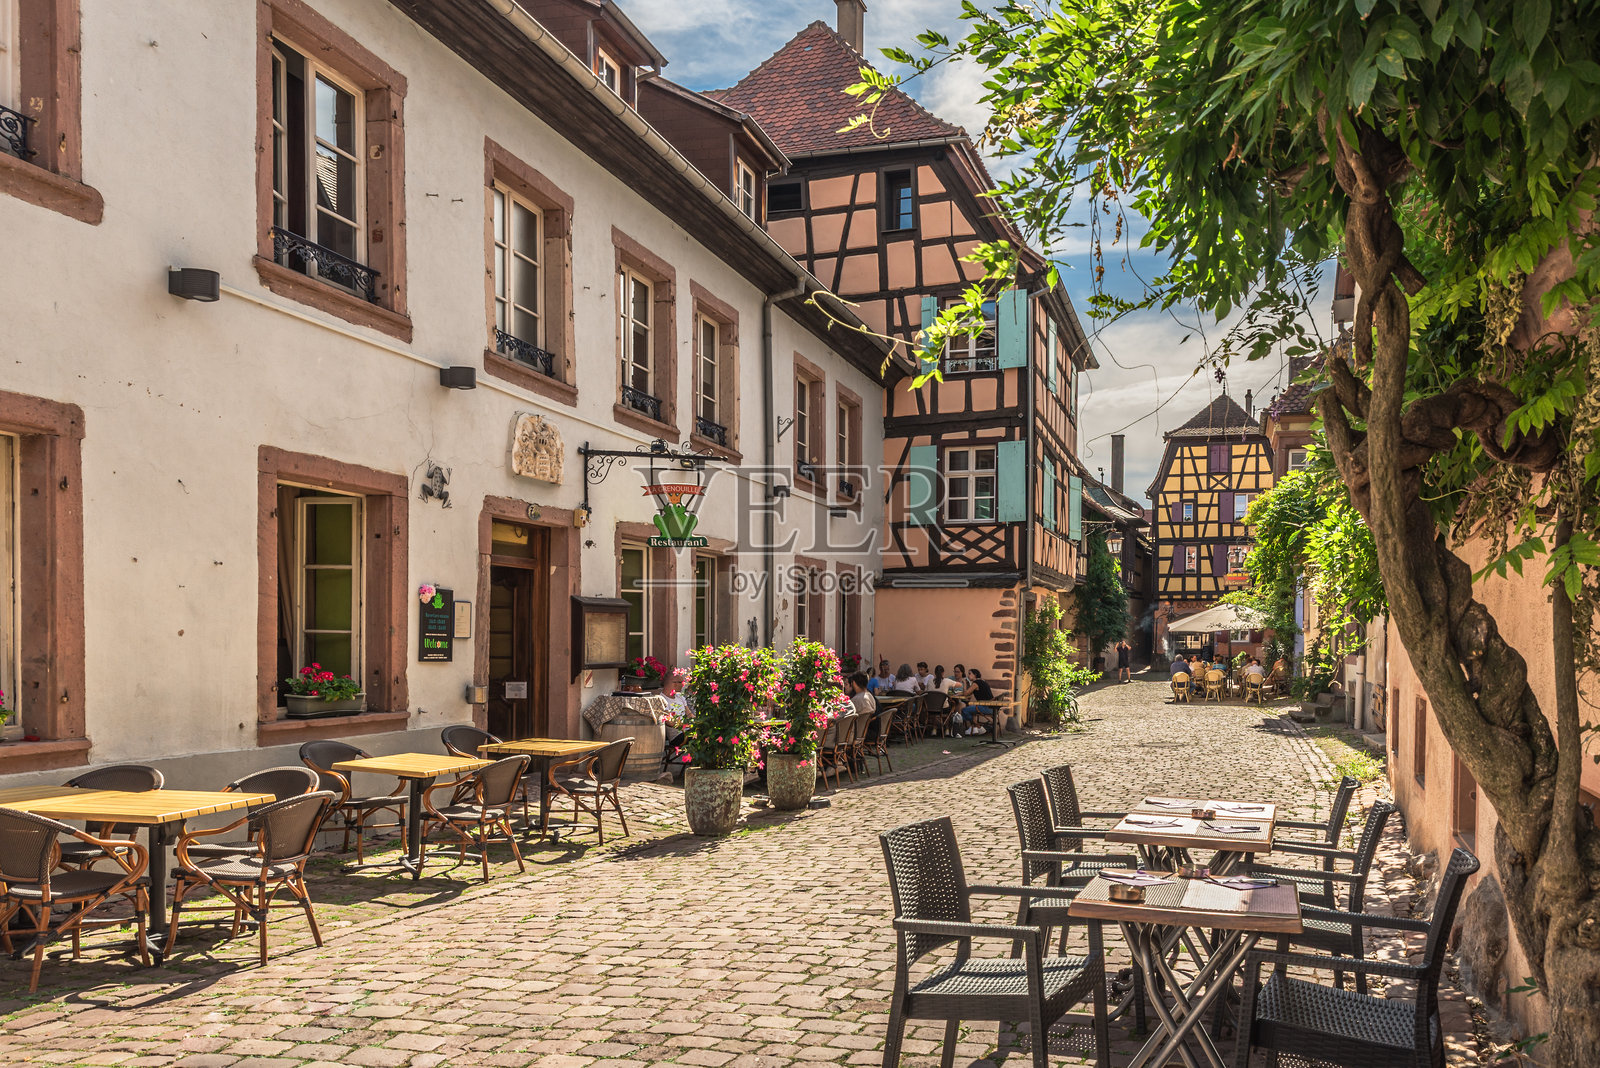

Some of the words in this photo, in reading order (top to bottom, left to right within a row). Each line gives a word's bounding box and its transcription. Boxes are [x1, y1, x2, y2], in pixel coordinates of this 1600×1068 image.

[657, 485, 700, 493] GRENOUILLE
[650, 538, 704, 546] Restaurant
[424, 638, 448, 648] Welcome
